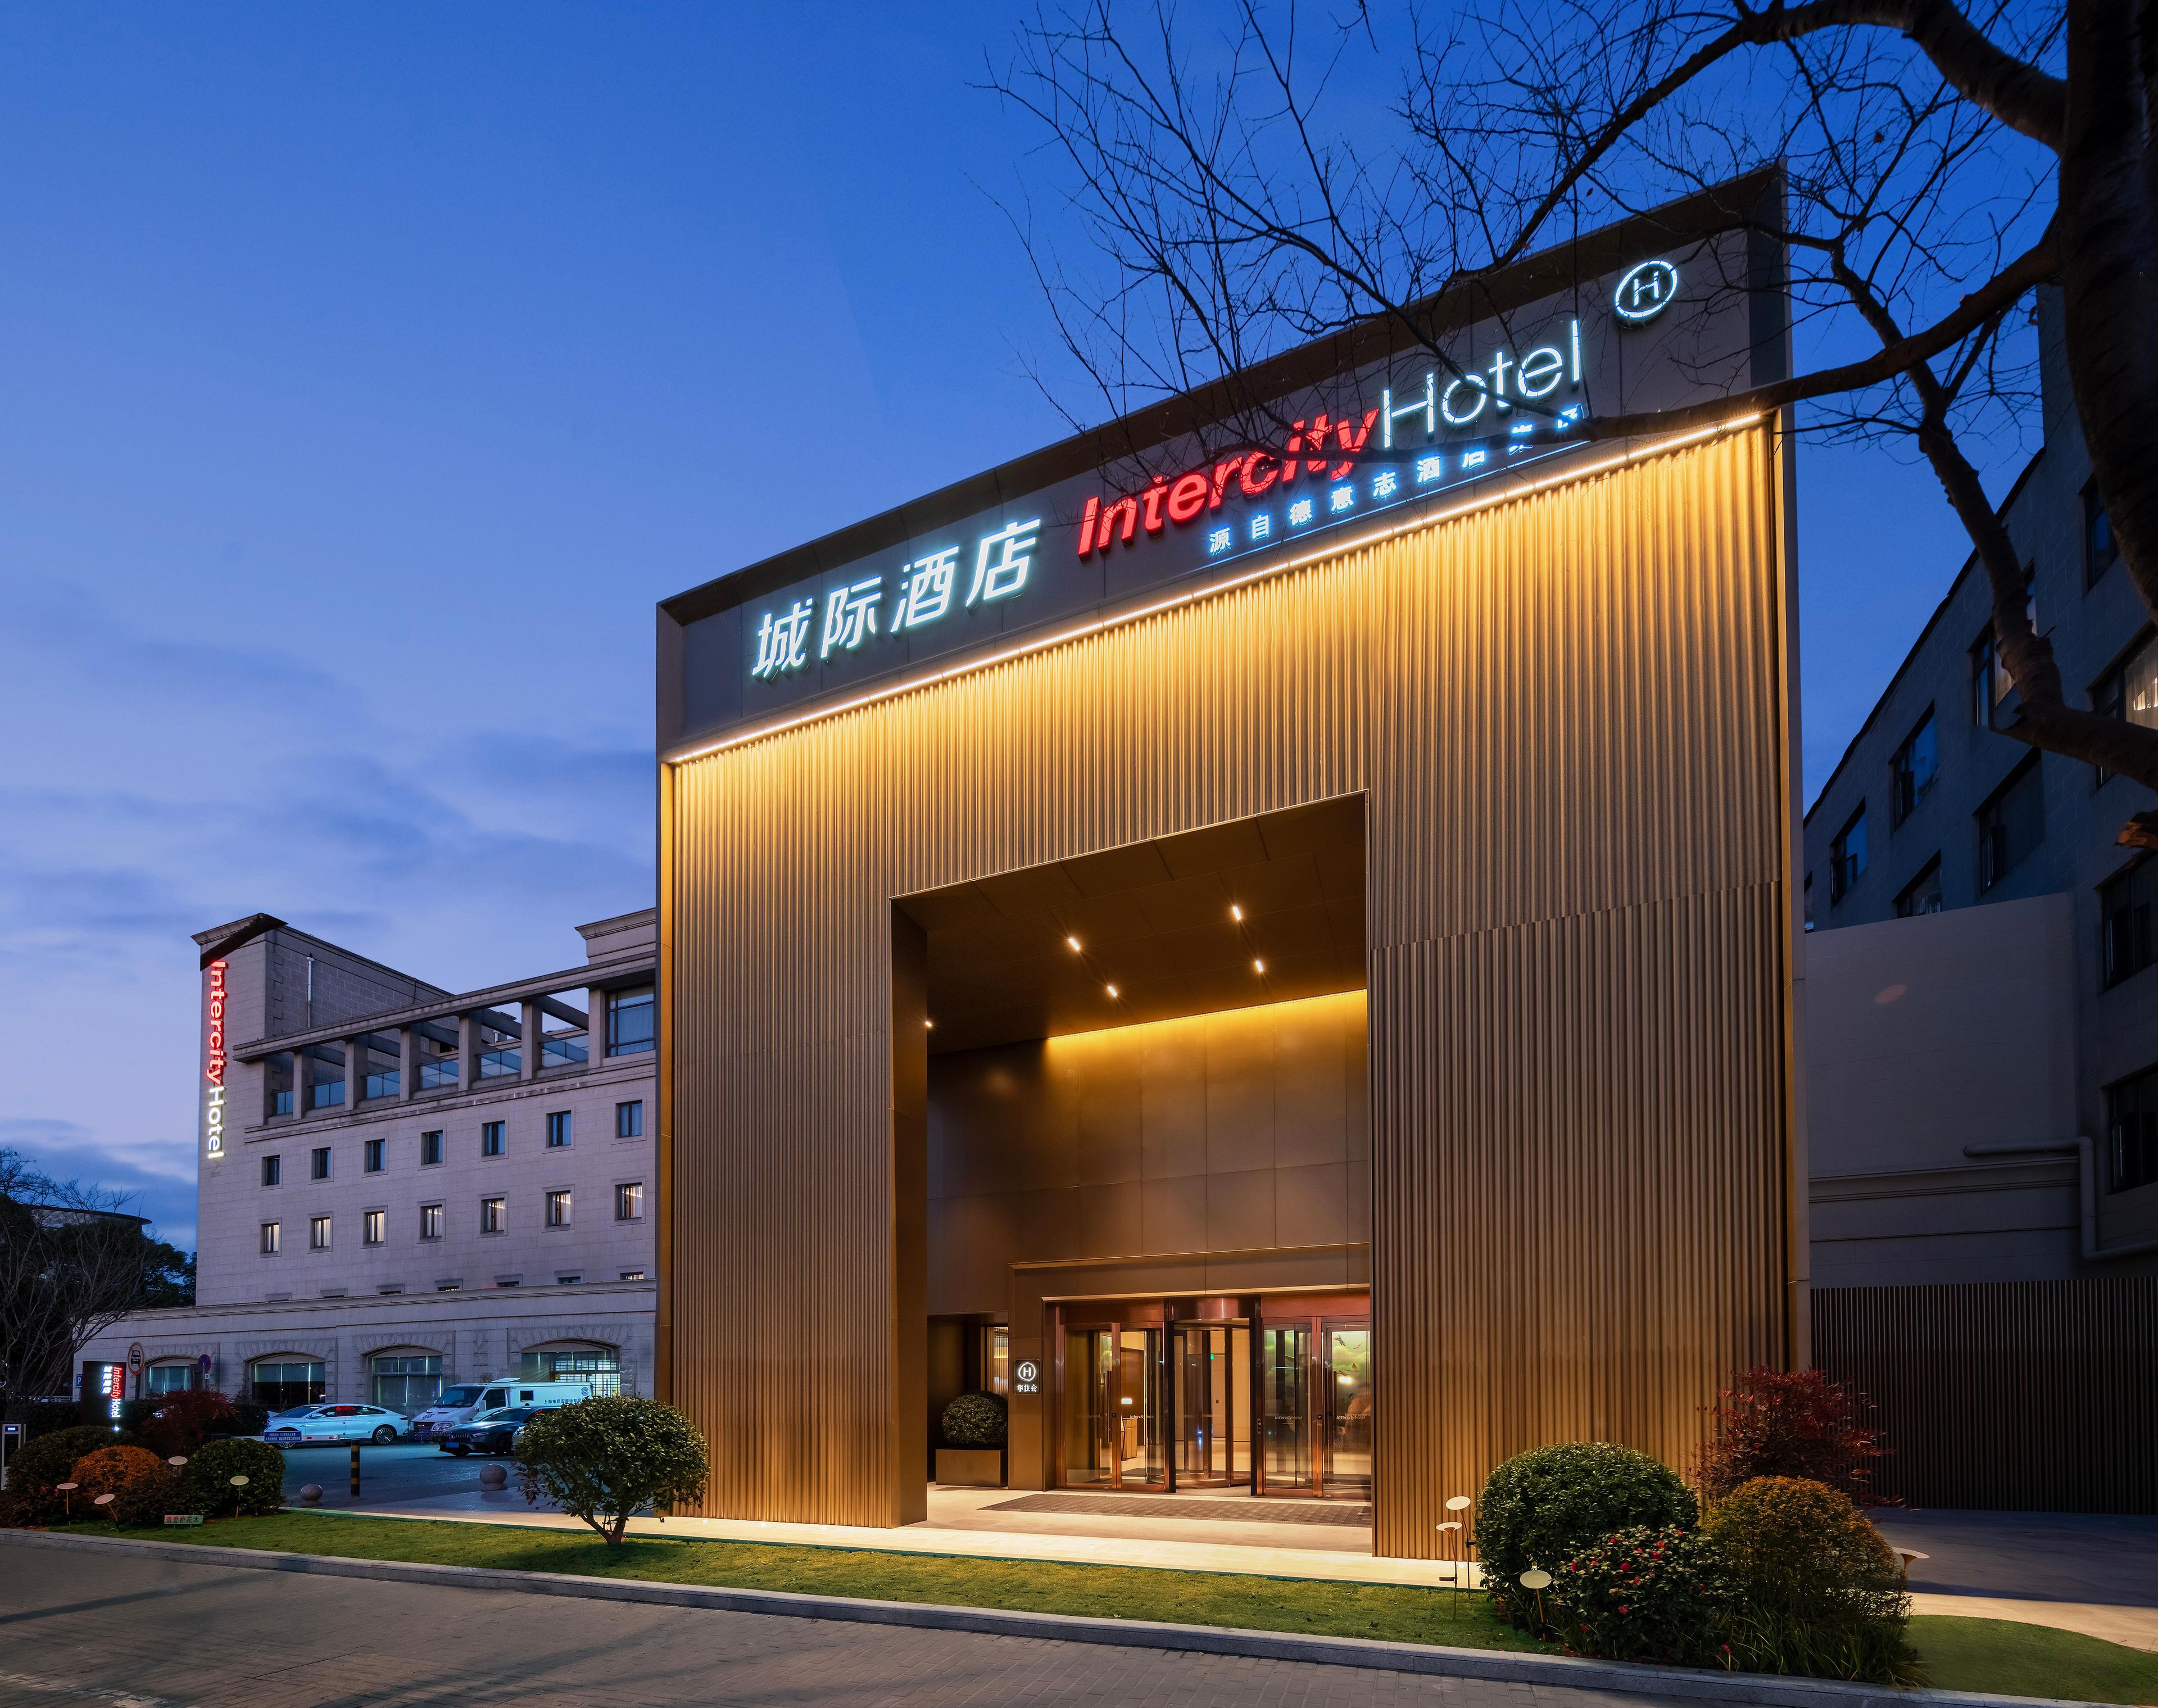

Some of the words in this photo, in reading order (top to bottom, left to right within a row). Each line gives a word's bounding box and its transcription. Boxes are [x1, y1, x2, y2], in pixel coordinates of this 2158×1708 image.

[751, 517, 1042, 678] 城际酒店
[206, 961, 228, 1159] IntercityHotel
[78, 1377, 81, 1385] P
[110, 1367, 122, 1417] IntercityHotel
